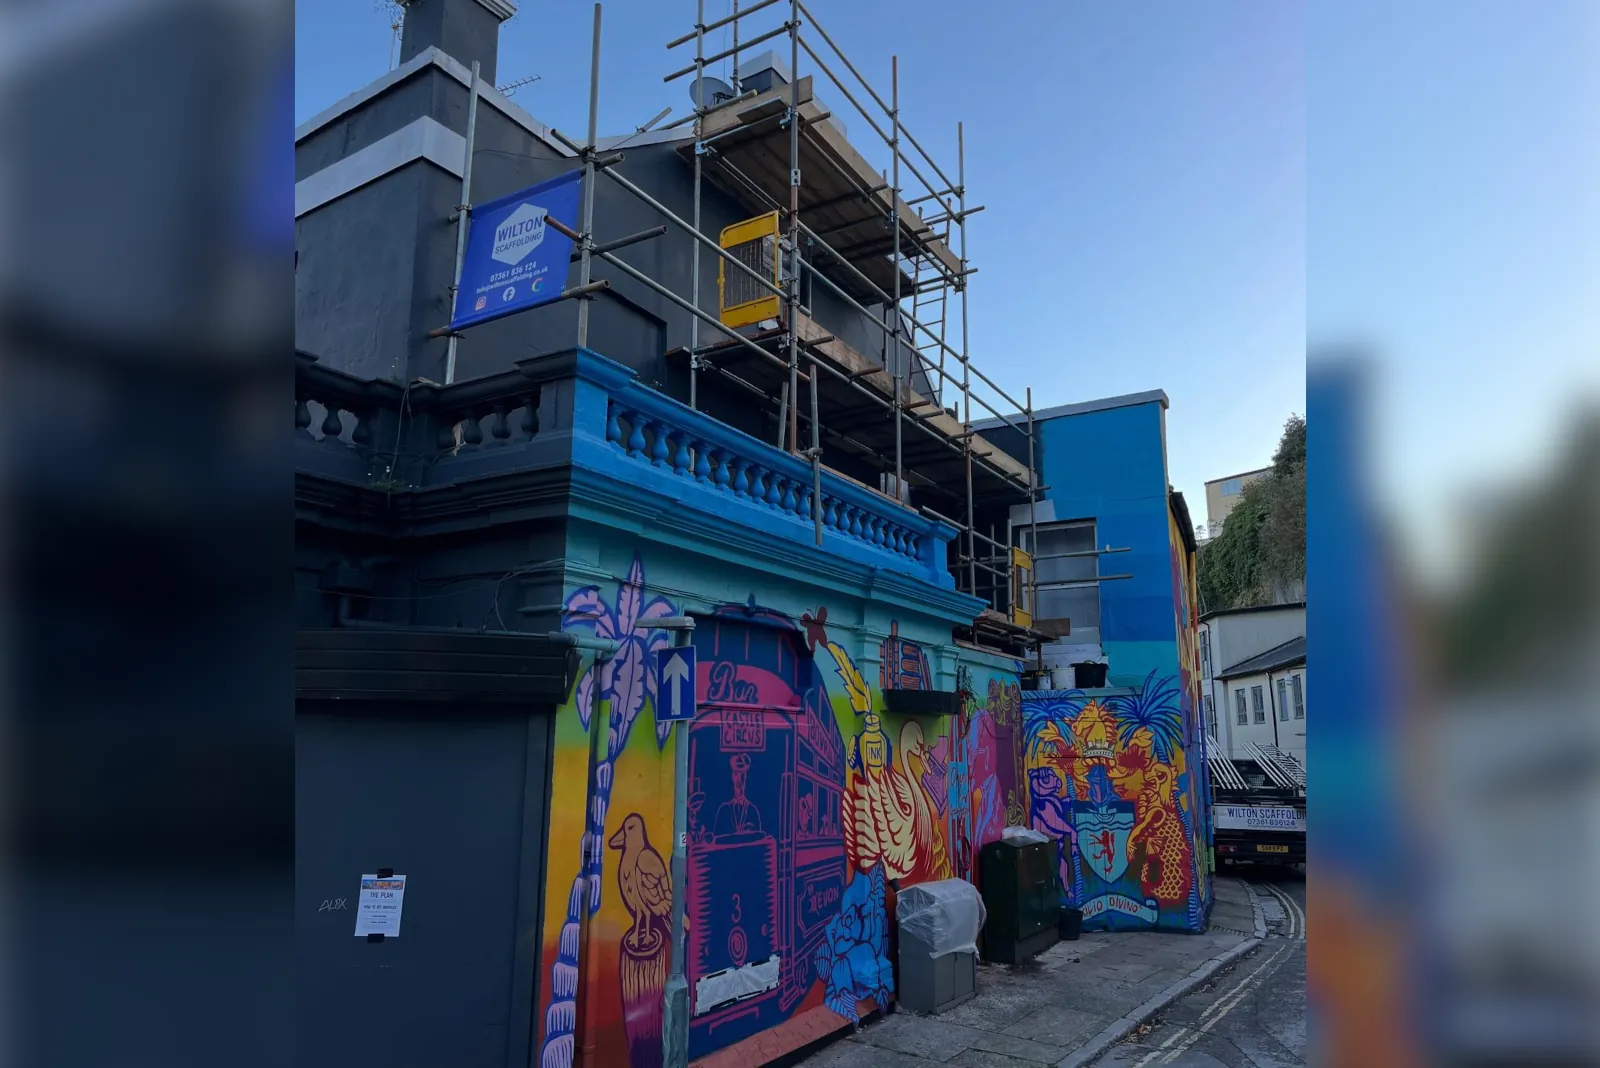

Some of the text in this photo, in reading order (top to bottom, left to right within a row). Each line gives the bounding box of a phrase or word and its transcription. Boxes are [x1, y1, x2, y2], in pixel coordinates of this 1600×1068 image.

[498, 214, 543, 242] WILTON
[494, 231, 542, 254] SCAFFOLDING
[525, 260, 537, 271] 124
[726, 711, 761, 729] CASTLE
[868, 747, 881, 760] INK
[1227, 808, 1258, 819] WILTON
